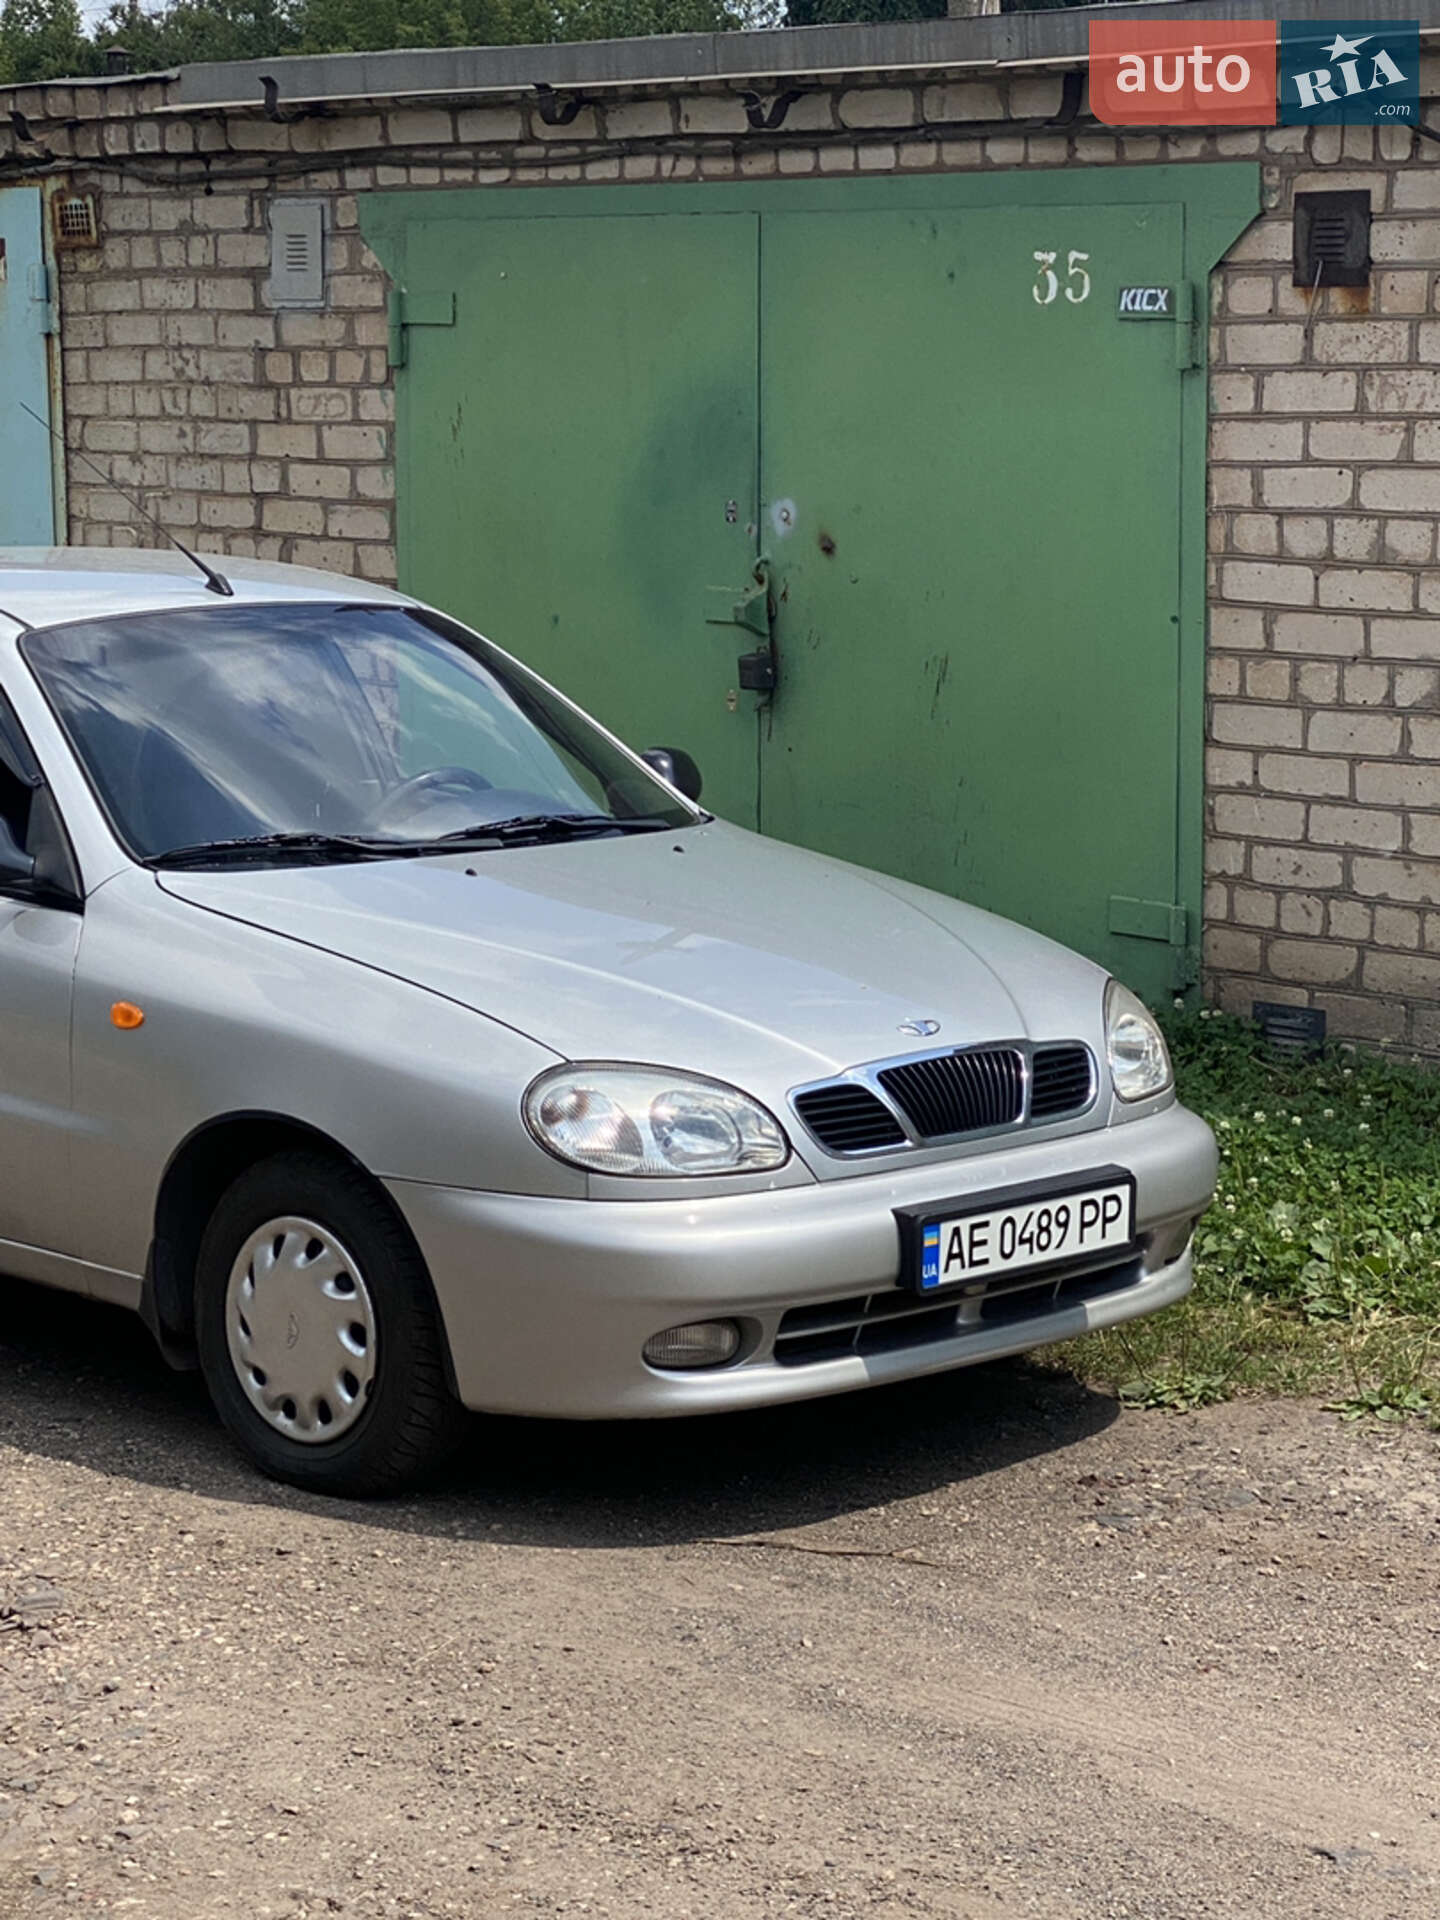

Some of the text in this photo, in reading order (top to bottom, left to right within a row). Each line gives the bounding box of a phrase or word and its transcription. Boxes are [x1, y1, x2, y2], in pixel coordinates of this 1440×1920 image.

[1033, 250, 1090, 304] 35
[1119, 288, 1168, 311] KICX
[943, 1194, 1122, 1273] AE 0489 PP
[922, 1263, 938, 1279] UA
